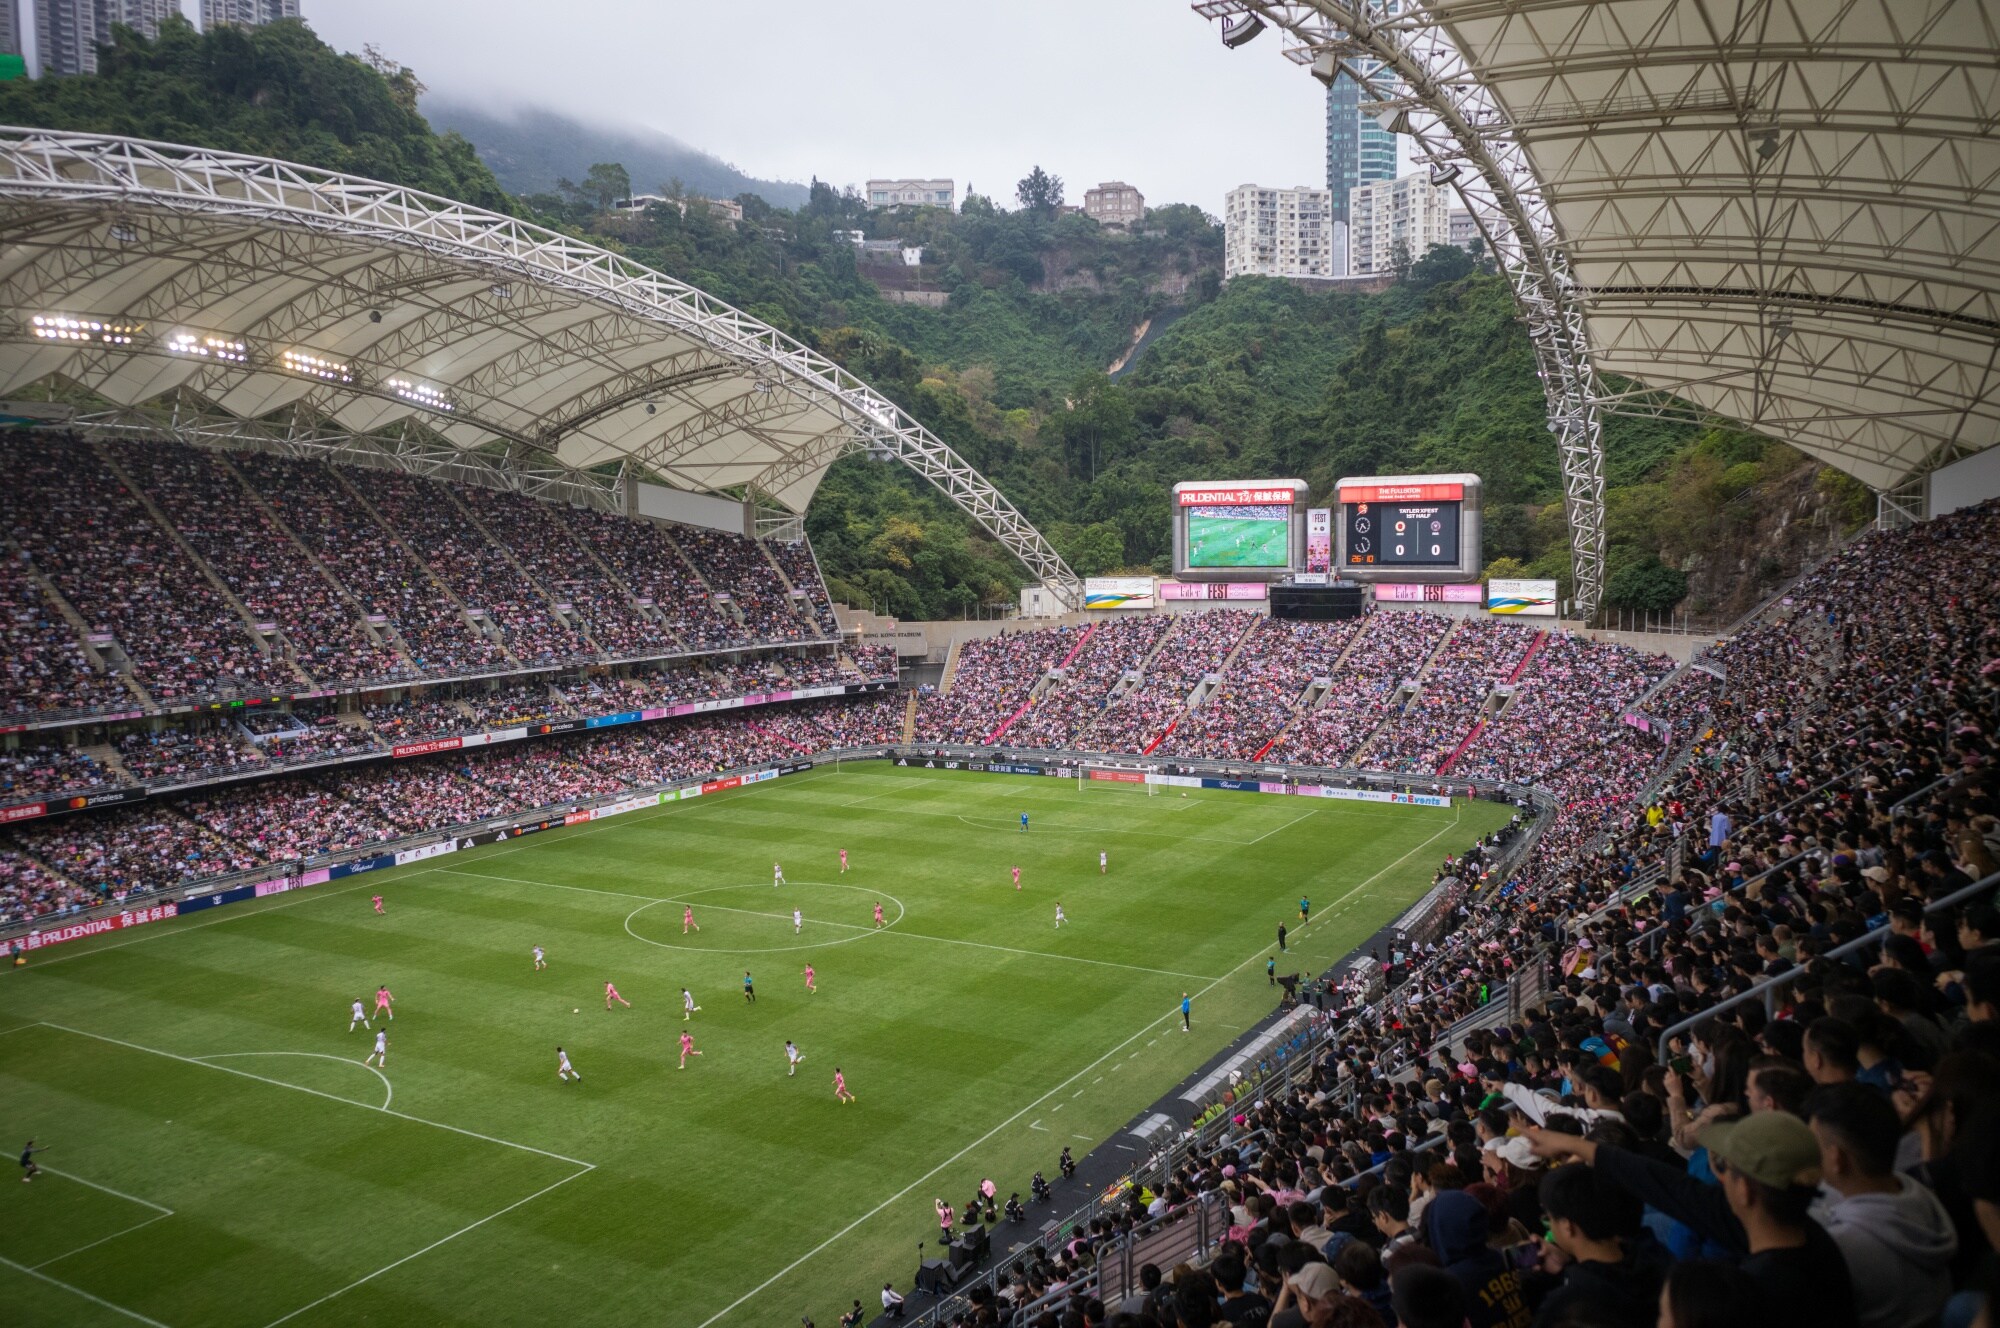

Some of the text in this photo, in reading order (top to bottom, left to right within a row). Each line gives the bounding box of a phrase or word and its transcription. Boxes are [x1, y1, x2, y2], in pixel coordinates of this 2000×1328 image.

[1181, 492, 1236, 502] PRUDENTIAL
[1395, 544, 1405, 556] 0
[1431, 544, 1441, 556] 0
[551, 723, 574, 731] priceless
[396, 744, 429, 755] PRUDENTIAL
[745, 771, 774, 783] ProEvents
[87, 793, 125, 805] priceless
[1391, 793, 1441, 806] ProEvents
[350, 860, 376, 873] Chopard
[121, 904, 178, 927] 保誠保險
[43, 919, 114, 944] PRUDENTIAL
